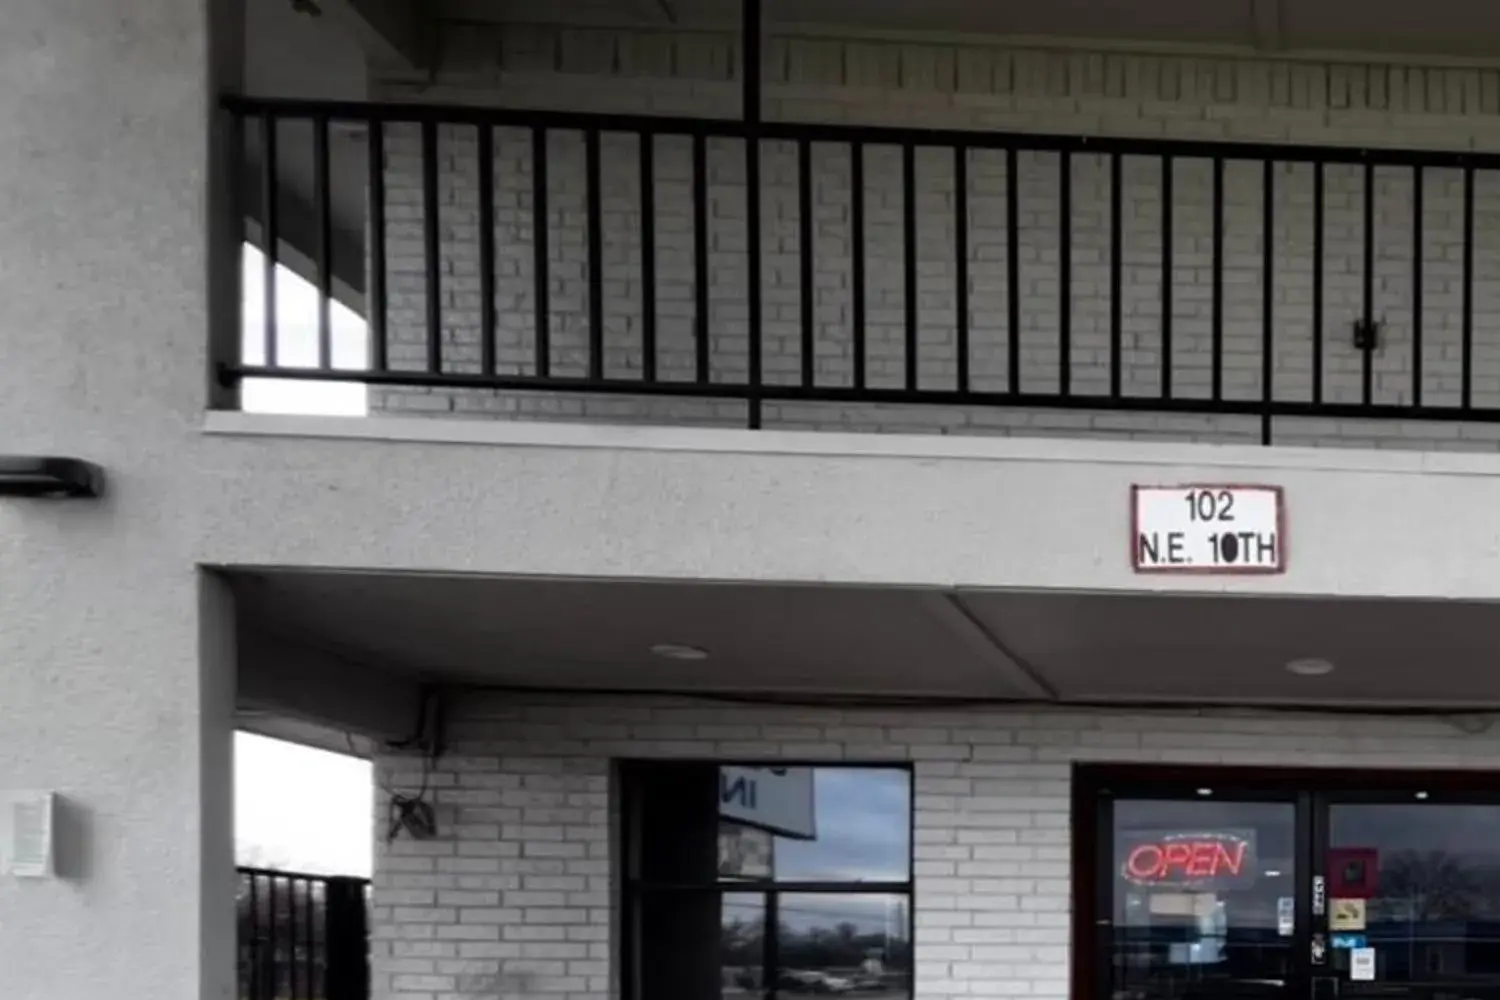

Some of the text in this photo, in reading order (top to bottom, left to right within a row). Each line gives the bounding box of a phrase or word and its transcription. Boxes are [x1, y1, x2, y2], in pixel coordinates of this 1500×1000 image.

[1185, 490, 1235, 522] 102
[1139, 532, 1276, 564] N.E. 10TH
[1128, 840, 1249, 878] OPEN
